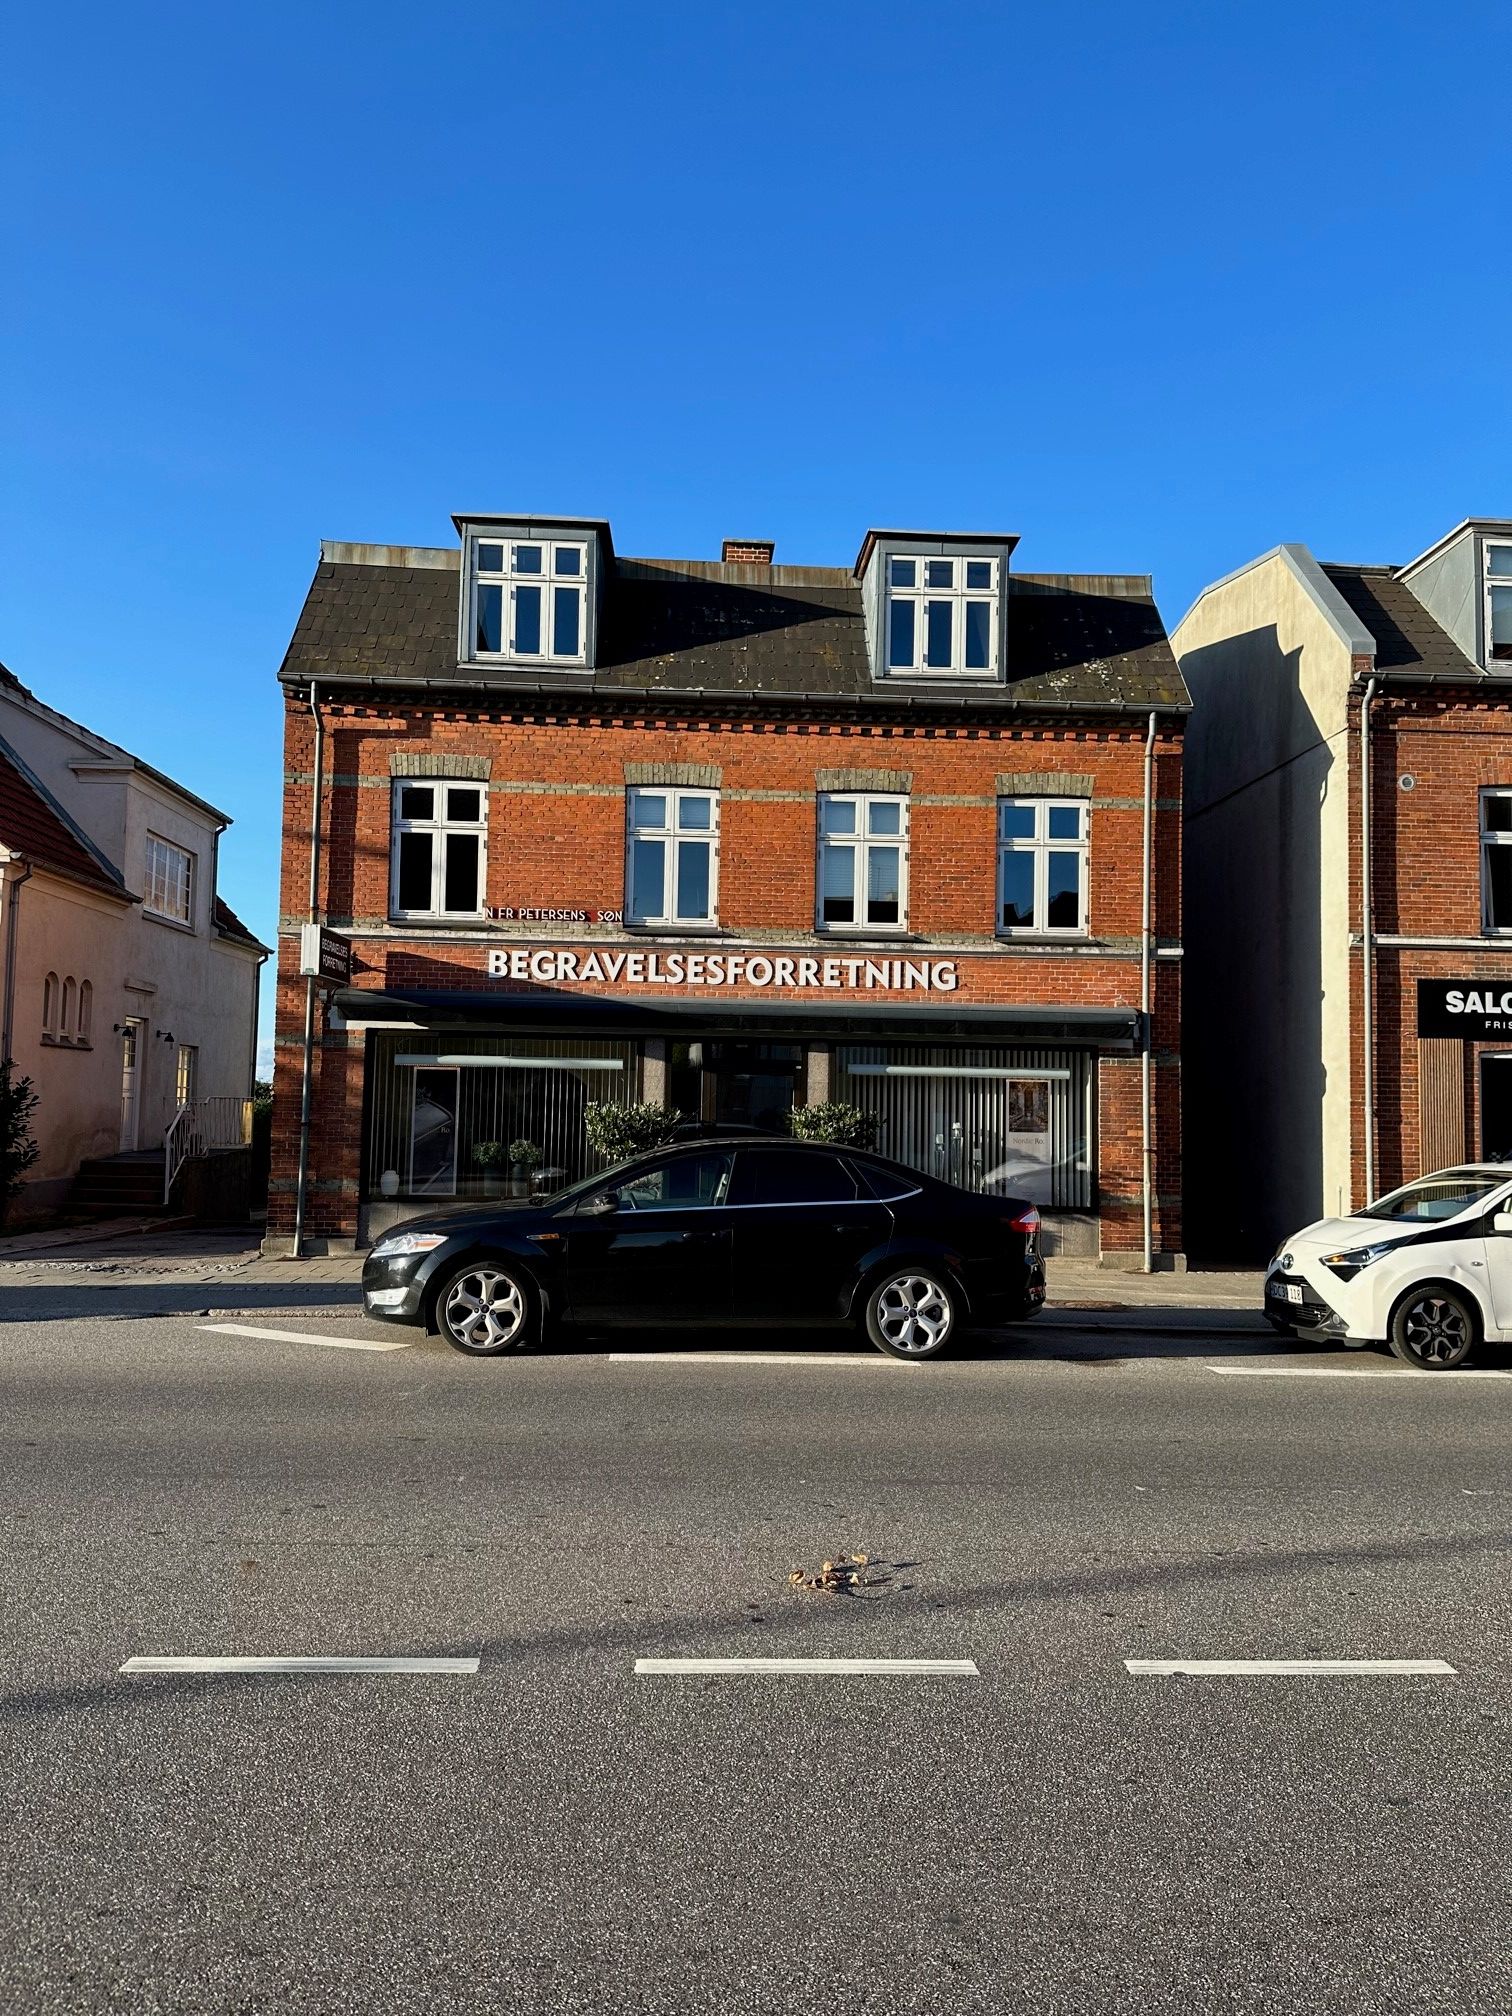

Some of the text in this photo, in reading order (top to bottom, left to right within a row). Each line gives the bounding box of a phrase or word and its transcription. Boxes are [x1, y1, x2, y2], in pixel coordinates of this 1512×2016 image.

[498, 907, 513, 919] FR
[520, 908, 585, 921] PETERSENS
[597, 911, 622, 921] SØN
[322, 938, 348, 958] BEGRAVELSES
[322, 954, 347, 973] FORRETNING
[489, 949, 957, 990] BEGRAVELSESFORRETNING
